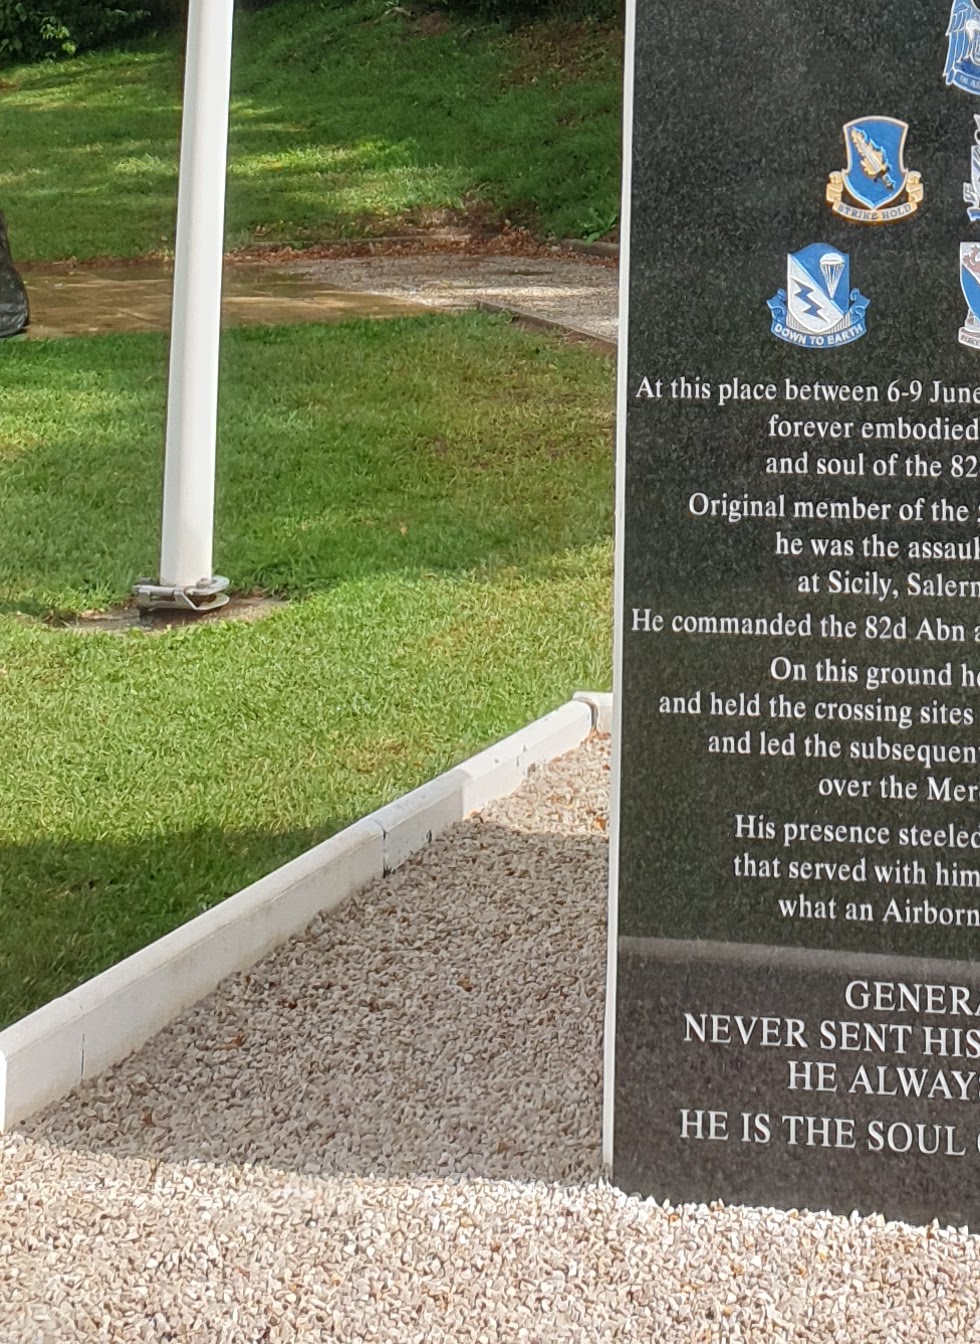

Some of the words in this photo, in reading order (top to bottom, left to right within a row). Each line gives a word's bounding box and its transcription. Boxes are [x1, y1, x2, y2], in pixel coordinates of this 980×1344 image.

[837, 203, 878, 220] STRIKE
[882, 203, 912, 219] HOLD
[774, 323, 806, 345] DOWN
[809, 335, 824, 346] TO
[827, 323, 863, 345] EARTH
[635, 375, 664, 399] At
[670, 375, 712, 400] this
[717, 376, 777, 407] place
[784, 377, 879, 403] between
[886, 378, 923, 403] 6-9
[768, 413, 855, 439] forever
[861, 416, 980, 442] embodied
[765, 450, 809, 475] and
[816, 452, 865, 476] soul
[872, 453, 899, 477] of
[904, 453, 943, 480] the
[688, 492, 786, 524] Original
[792, 495, 892, 521] member
[898, 497, 926, 522] of
[930, 497, 970, 523] the
[774, 530, 804, 556] he
[810, 538, 855, 557] was
[861, 533, 900, 559] the
[797, 572, 820, 594] at
[828, 569, 899, 603] Sicily,
[631, 607, 664, 633] He
[671, 611, 812, 637] commanded
[820, 613, 857, 639] the
[864, 615, 907, 640] 82d
[914, 617, 966, 642] Abn
[770, 656, 807, 681] On
[814, 657, 859, 684] this
[865, 662, 953, 691] ground
[658, 690, 702, 715] and
[709, 691, 761, 717] held
[768, 693, 807, 720] the
[814, 697, 913, 730] crossing
[920, 699, 974, 726] sites
[708, 730, 752, 755] and
[759, 730, 796, 757] led
[803, 732, 842, 759] the
[818, 778, 872, 798] over
[879, 774, 918, 800] the
[734, 813, 776, 840] His
[783, 822, 890, 847] presence
[733, 851, 782, 879] that
[788, 856, 867, 883] served
[873, 859, 927, 885] with
[778, 892, 837, 920] what
[844, 902, 874, 922] an
[683, 1012, 809, 1049] NEVER
[819, 1019, 913, 1055] SENT
[787, 1060, 838, 1093] HE
[679, 1108, 730, 1141] HE
[740, 1112, 771, 1144] IS
[781, 1114, 857, 1149] THE
[867, 1120, 967, 1156] SOUL
